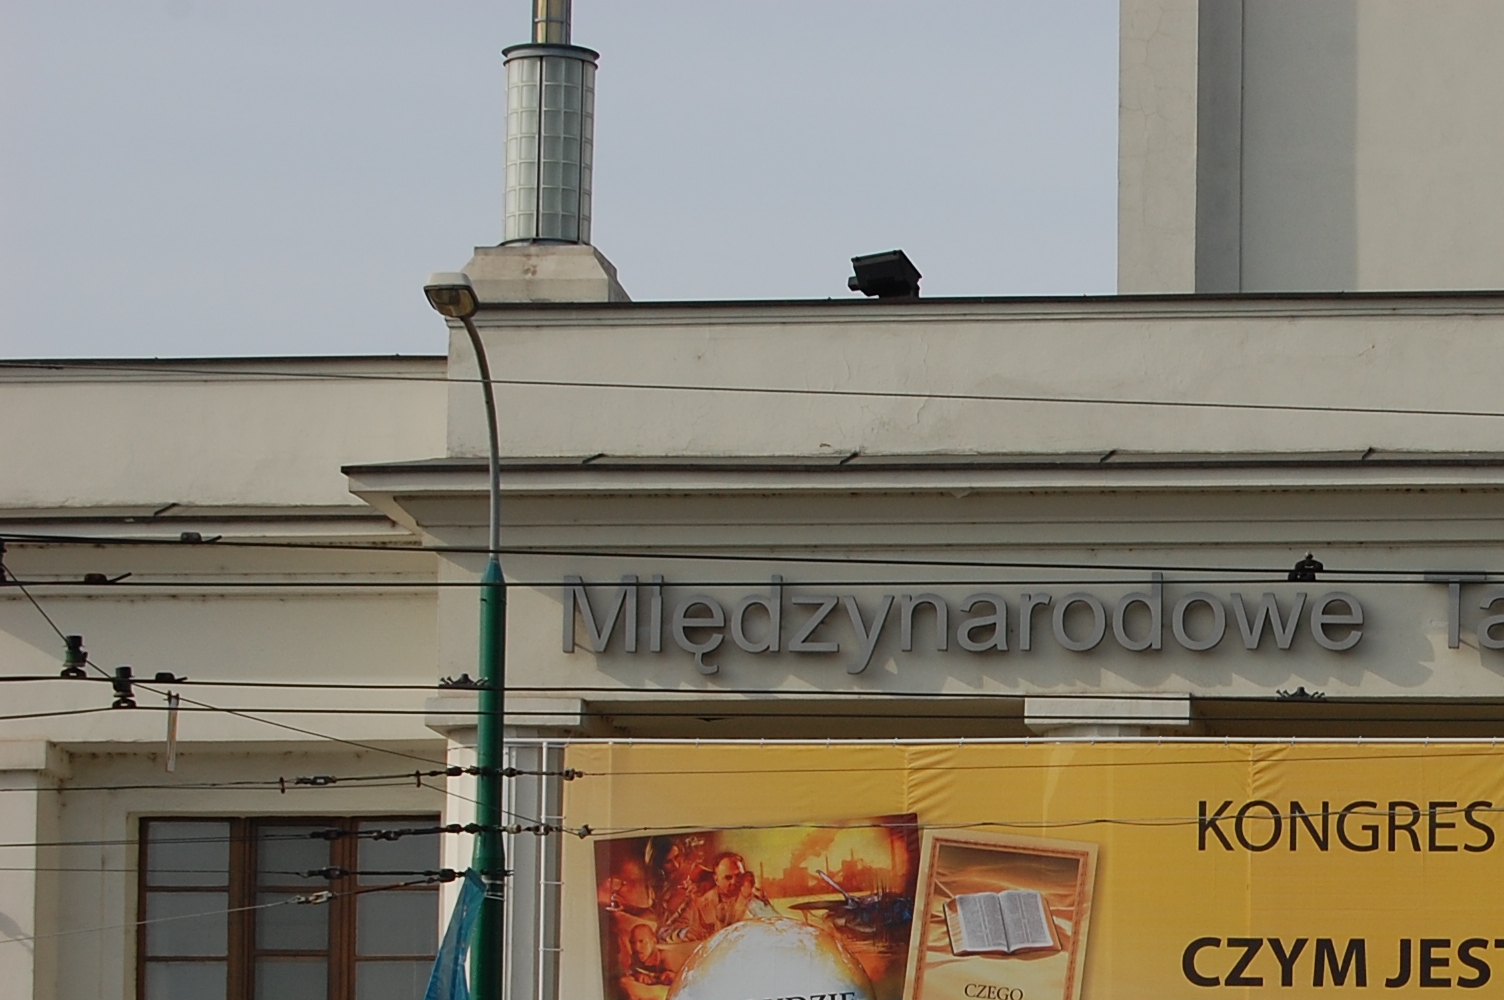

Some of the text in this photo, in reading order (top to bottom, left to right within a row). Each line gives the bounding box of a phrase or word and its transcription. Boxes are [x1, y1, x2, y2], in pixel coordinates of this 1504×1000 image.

[561, 573, 1365, 676] Międzynarodowe
[1198, 800, 1495, 853] KONGRES
[1182, 937, 1367, 988] CZYM
